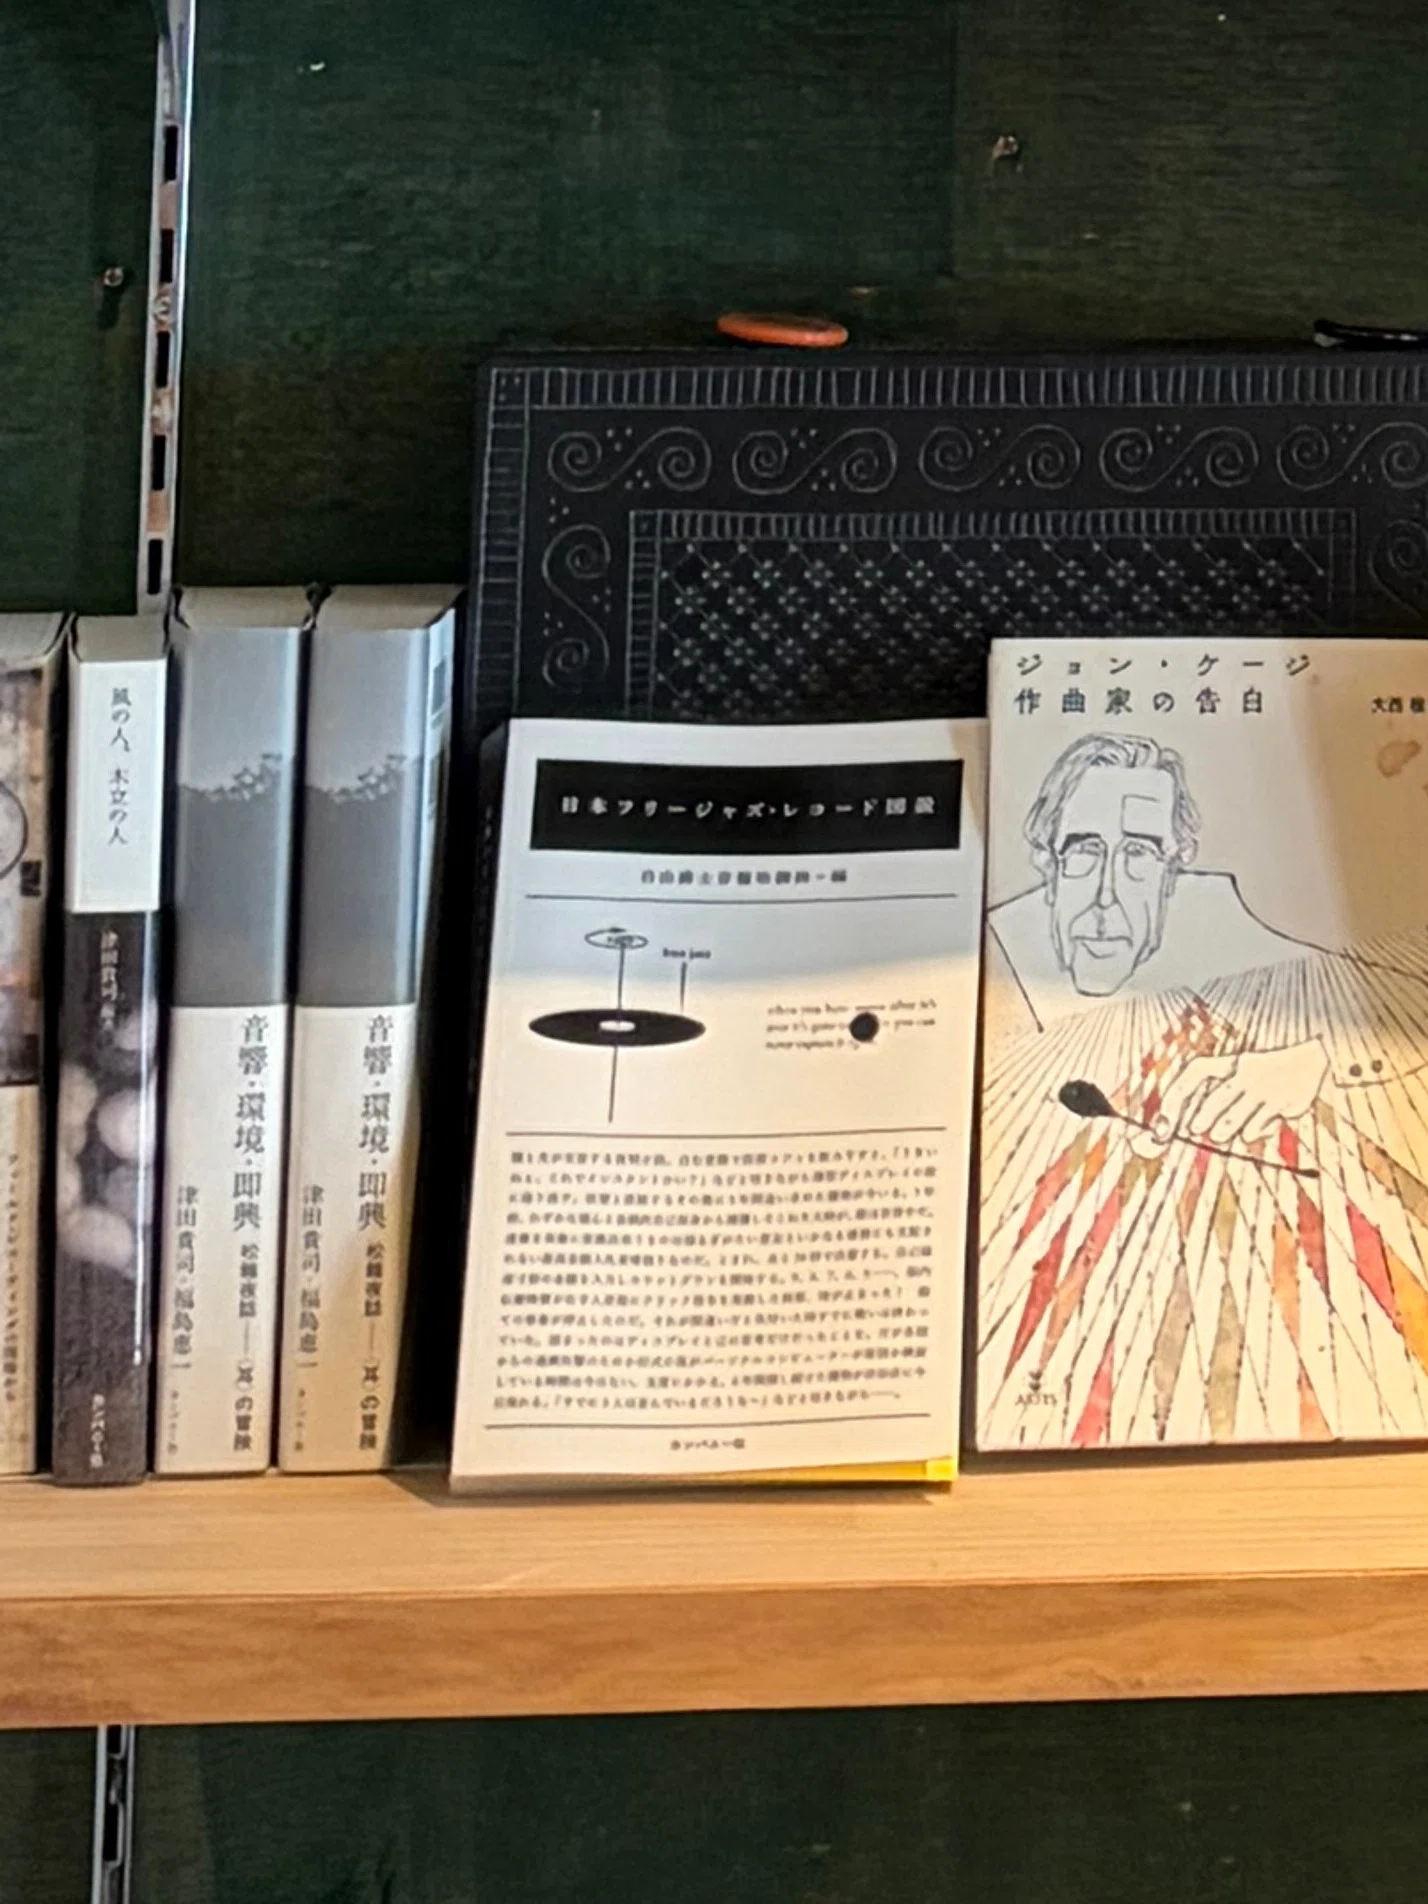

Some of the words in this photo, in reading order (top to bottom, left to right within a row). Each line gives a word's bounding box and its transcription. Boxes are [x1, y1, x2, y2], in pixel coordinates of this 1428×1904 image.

[1013, 686, 1267, 719] 作曲家の告白
[1015, 652, 1312, 679] ジョン・ケージ
[106, 686, 133, 847] 風の人、木立の人
[232, 1011, 271, 1232] 音響・環境・即興
[357, 1011, 396, 1232] 音響・環境・即興
